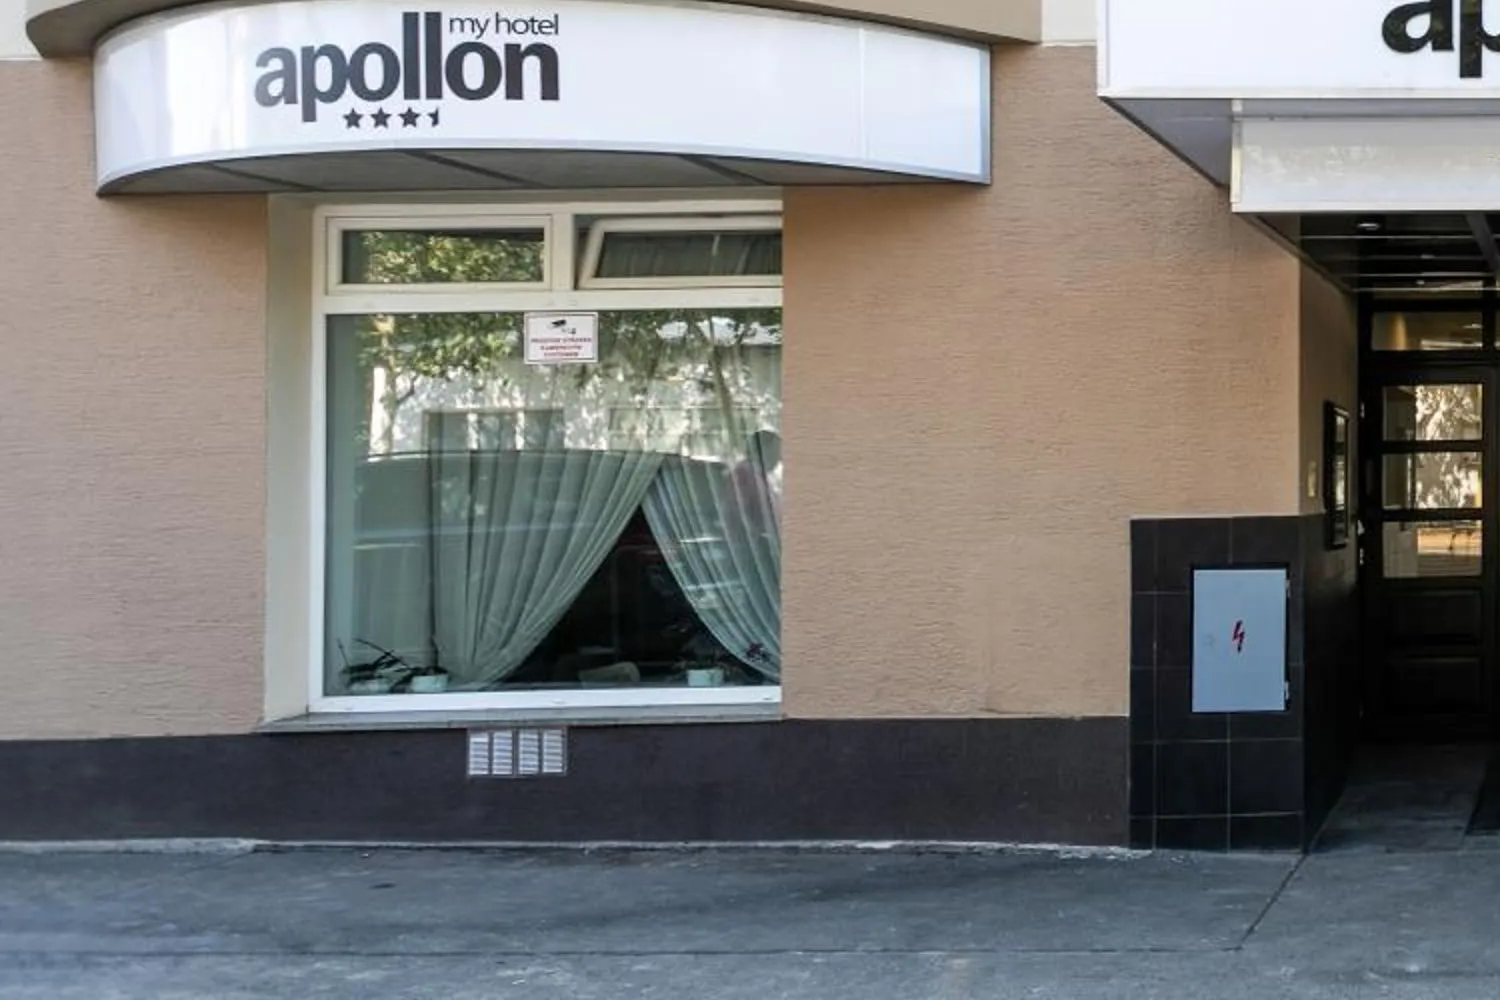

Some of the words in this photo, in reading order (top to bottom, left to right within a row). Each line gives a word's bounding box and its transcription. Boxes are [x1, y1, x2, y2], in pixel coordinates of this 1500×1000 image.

[449, 16, 490, 38] my
[495, 12, 560, 35] hotel
[254, 11, 560, 123] apollon
